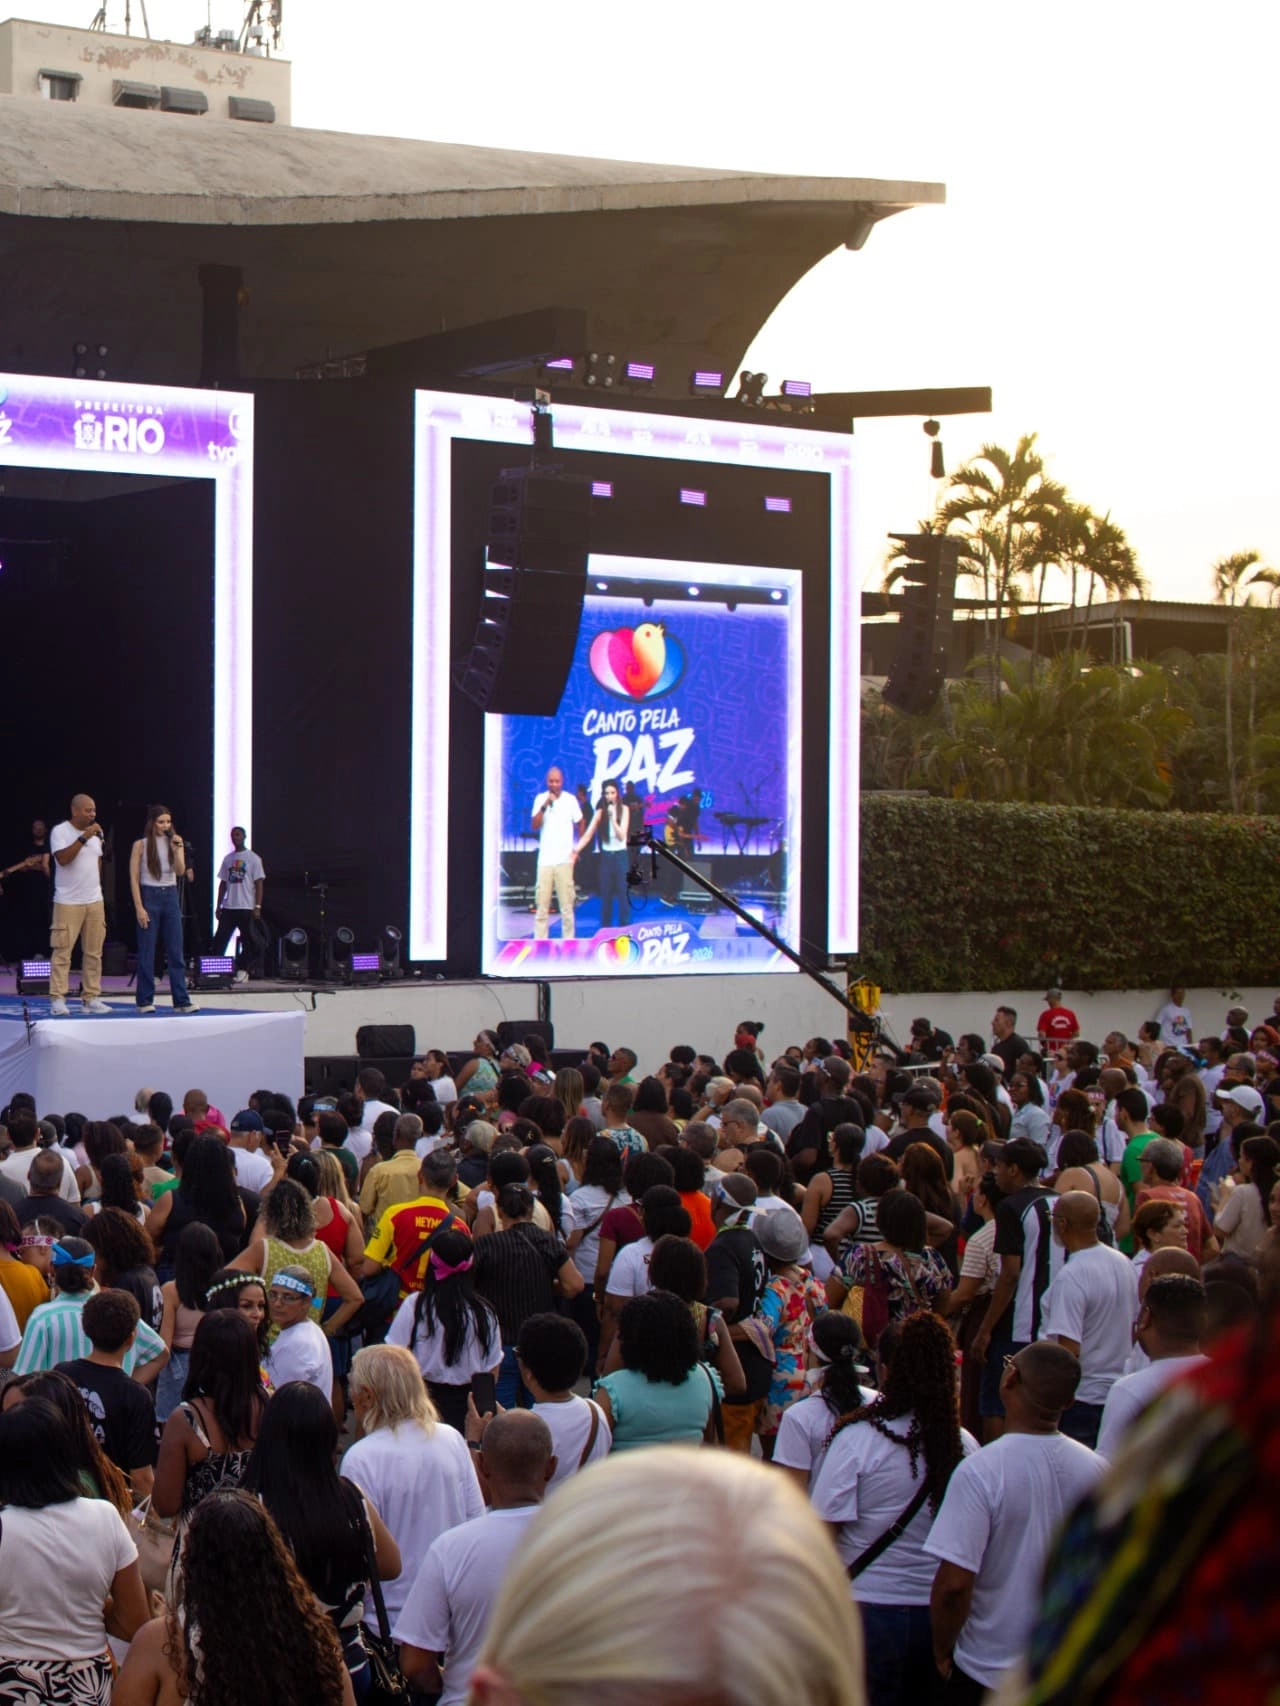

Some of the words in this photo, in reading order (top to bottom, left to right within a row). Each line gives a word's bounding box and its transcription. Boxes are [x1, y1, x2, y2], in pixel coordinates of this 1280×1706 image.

[73, 399, 164, 415] PREFEITURA
[103, 416, 165, 455] RIO
[582, 708, 637, 736] CANTO
[639, 706, 681, 733] PELA
[586, 727, 697, 812] PAZ
[637, 926, 663, 942] CANTO
[663, 923, 683, 937] PELA
[641, 931, 691, 966] PAZ
[414, 1215, 448, 1229] NEYM
